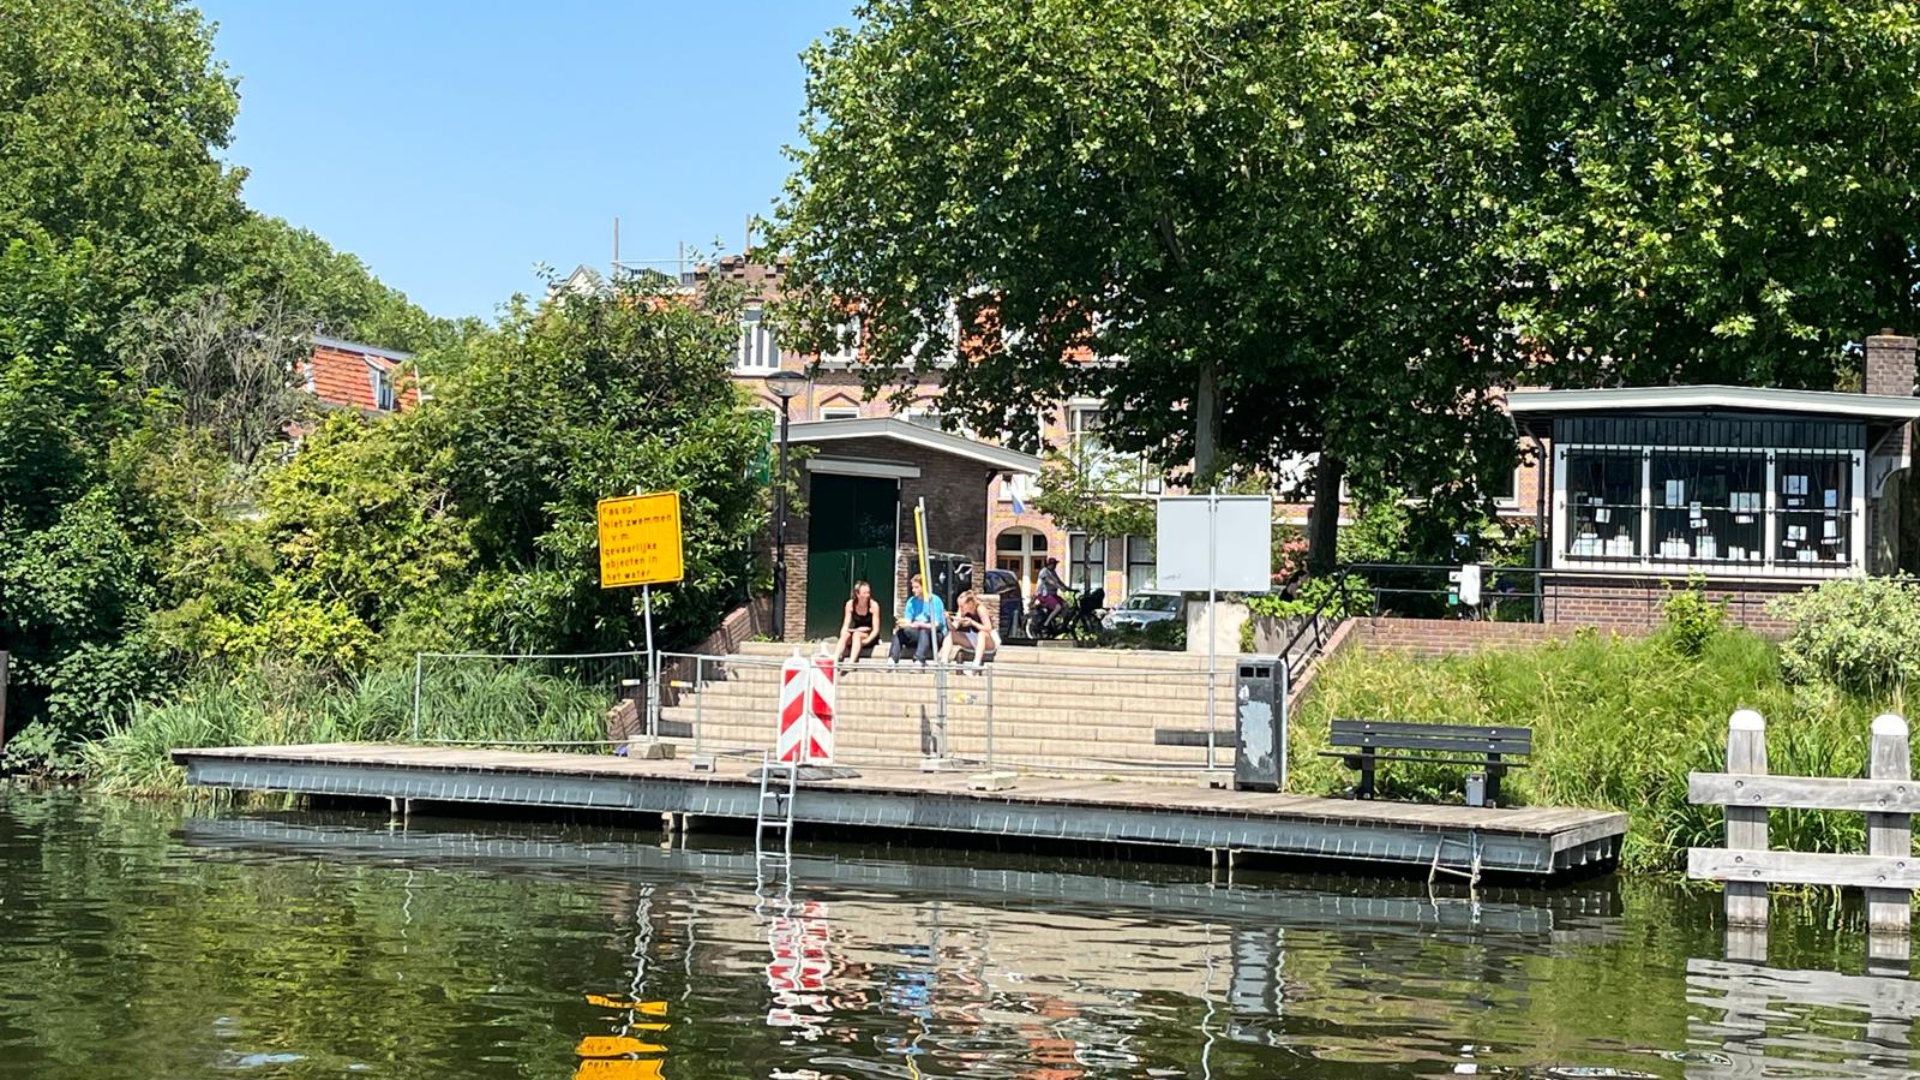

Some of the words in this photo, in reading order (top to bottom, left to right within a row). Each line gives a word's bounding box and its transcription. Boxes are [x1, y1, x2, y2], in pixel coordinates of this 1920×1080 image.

[603, 519, 623, 529] Niet
[626, 513, 672, 527] zwemmen
[605, 542, 657, 557] gevaarlijke
[605, 556, 645, 570] objecten
[648, 554, 658, 564] in
[606, 572, 621, 581] het
[624, 569, 651, 579] water
